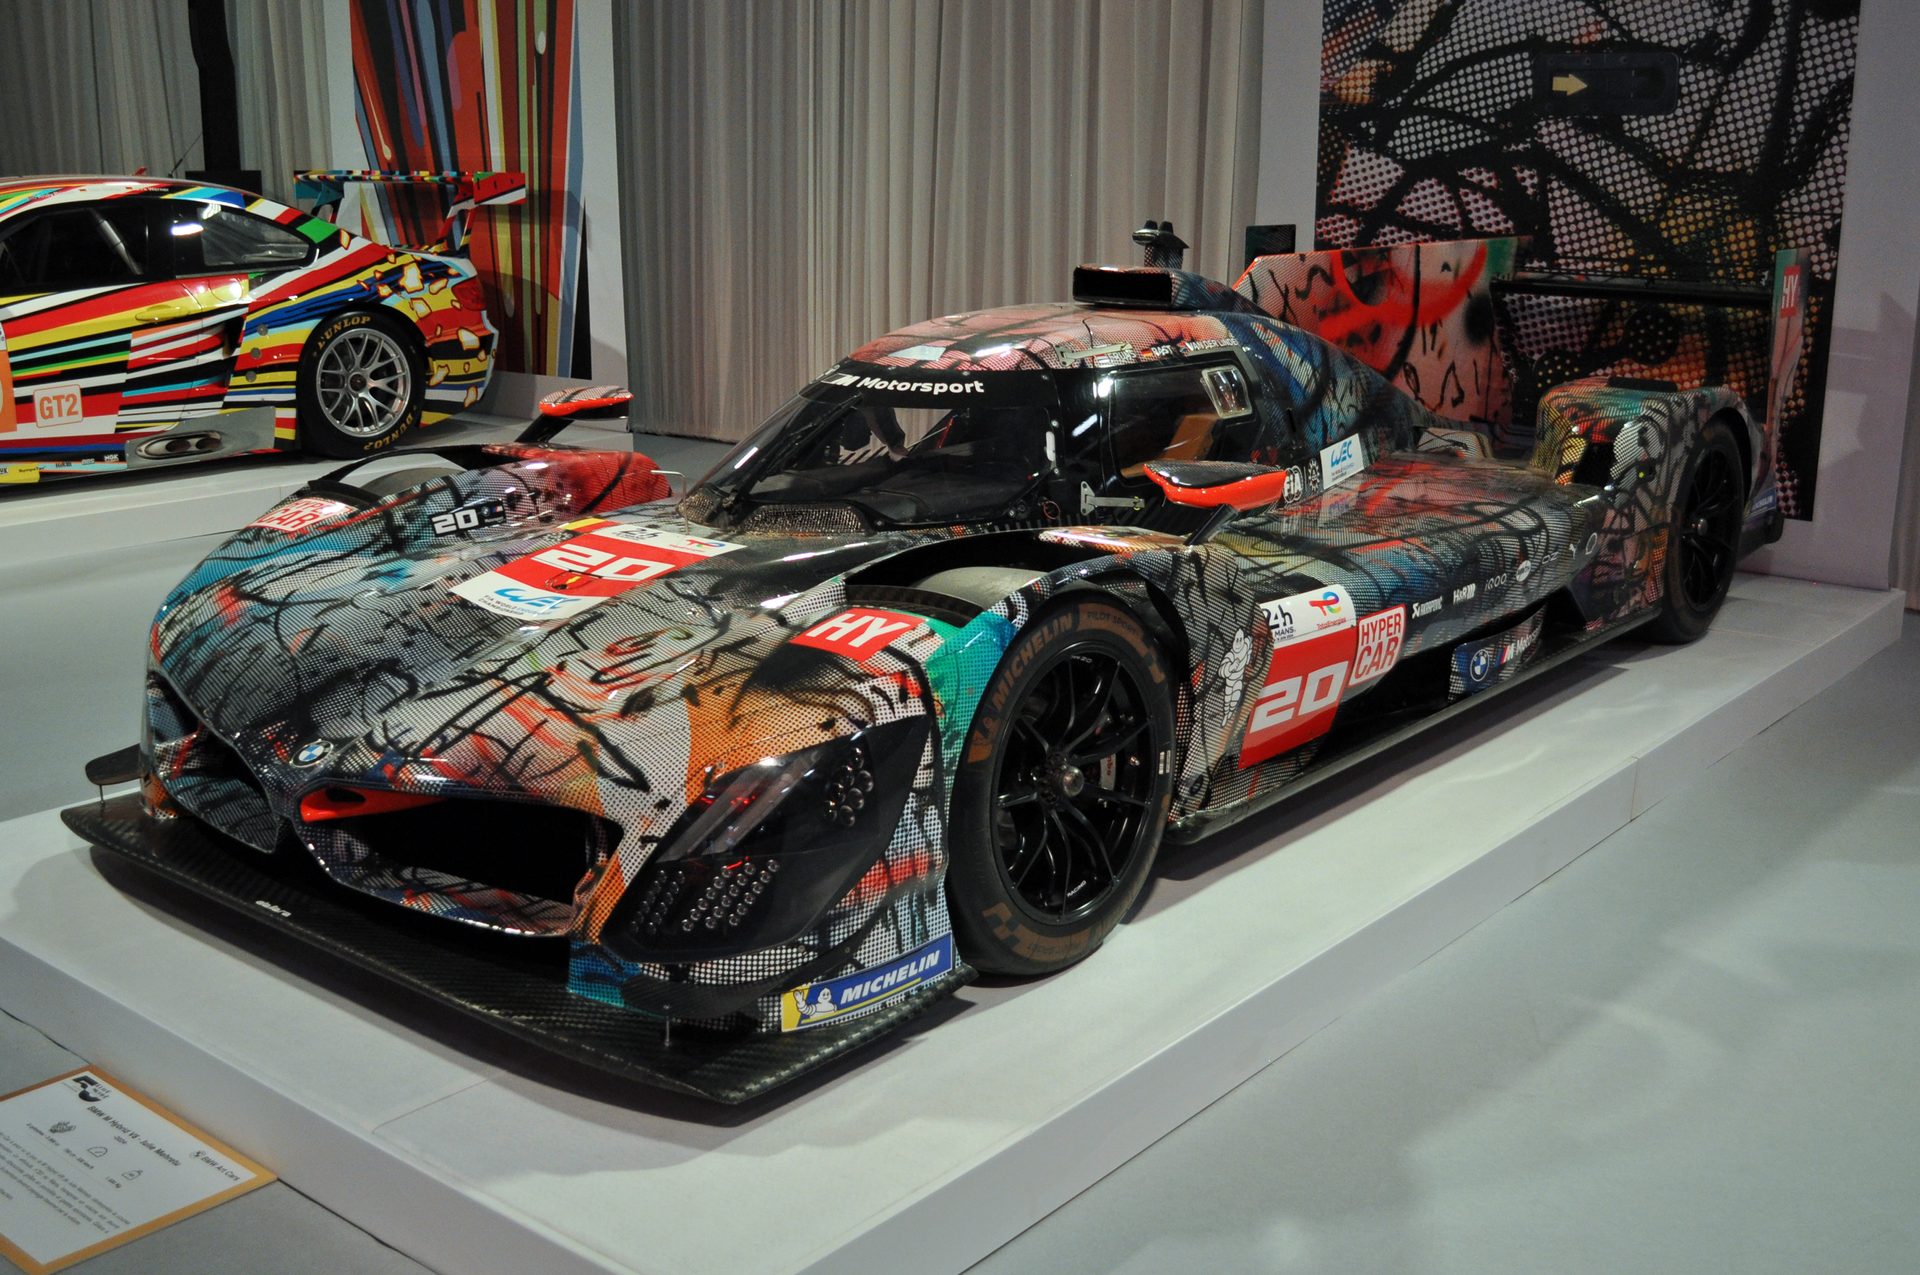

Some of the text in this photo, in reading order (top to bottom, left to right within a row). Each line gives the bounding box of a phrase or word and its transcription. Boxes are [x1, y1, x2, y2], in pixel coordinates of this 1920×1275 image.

[1781, 273, 1799, 309] HY
[1150, 344, 1173, 357] RAST
[859, 376, 985, 395] Motorsport
[39, 393, 79, 420] GT2
[259, 508, 319, 531] CAR
[431, 508, 479, 535] 20
[530, 543, 676, 582] 20
[805, 612, 912, 648] HY
[1360, 613, 1402, 646] HYPER
[990, 610, 1074, 710] MICHELIN
[1354, 636, 1400, 680] CAR
[1249, 660, 1349, 734] 20
[840, 949, 941, 1005] MICHELIN
